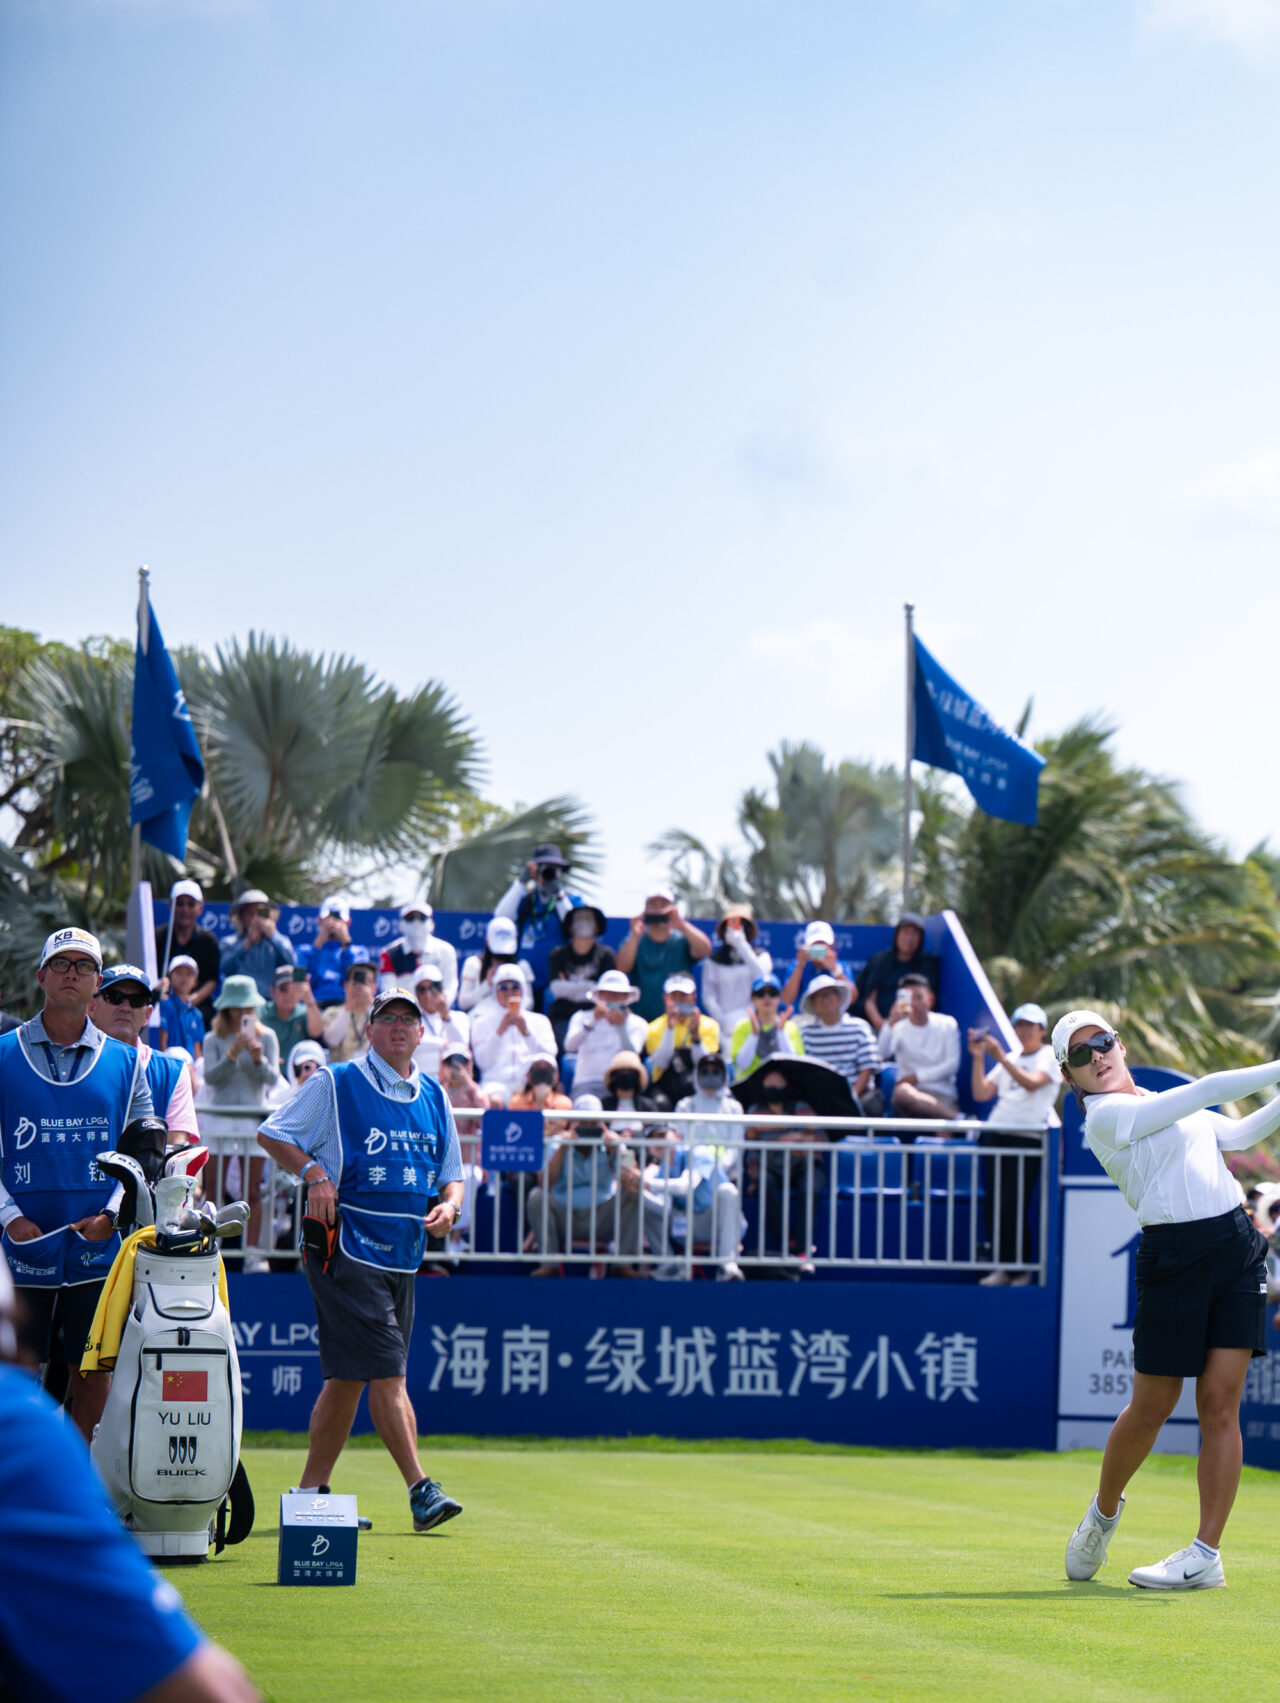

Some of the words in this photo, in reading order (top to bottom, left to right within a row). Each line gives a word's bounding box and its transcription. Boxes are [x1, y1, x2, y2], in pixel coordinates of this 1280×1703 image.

[54, 931, 73, 942] KB
[41, 1118, 64, 1127] BLUE
[66, 1118, 84, 1127] BAY
[86, 1117, 109, 1126] LPGA
[41, 1131, 109, 1143] 蓝湾大师赛
[390, 1130, 408, 1138] BLUE
[1110, 1231, 1143, 1330] 1
[429, 1323, 979, 1402] 海南·绿城蓝湾小镇
[1088, 1373, 1134, 1395] 385
[158, 1412, 181, 1425] YU
[188, 1412, 211, 1426] LIU
